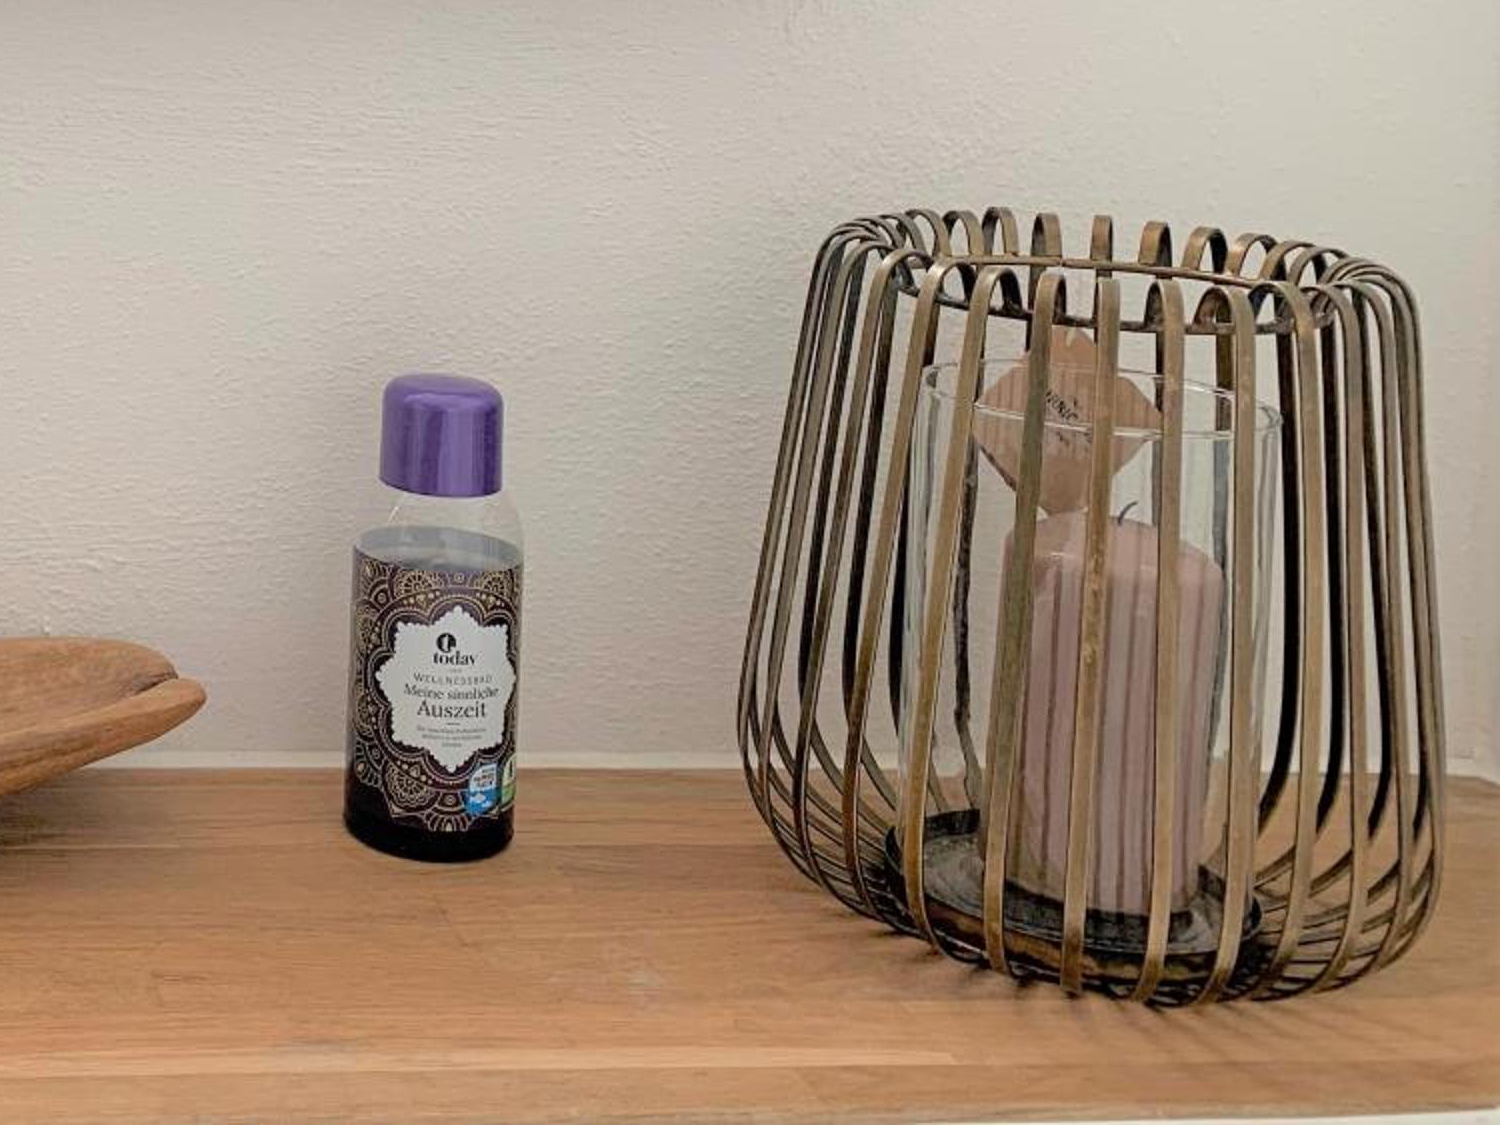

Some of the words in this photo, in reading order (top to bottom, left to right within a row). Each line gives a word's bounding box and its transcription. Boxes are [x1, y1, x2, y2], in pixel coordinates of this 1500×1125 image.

[433, 651, 476, 666] today
[404, 684, 444, 700] Meine
[417, 700, 486, 718] Auszeit
